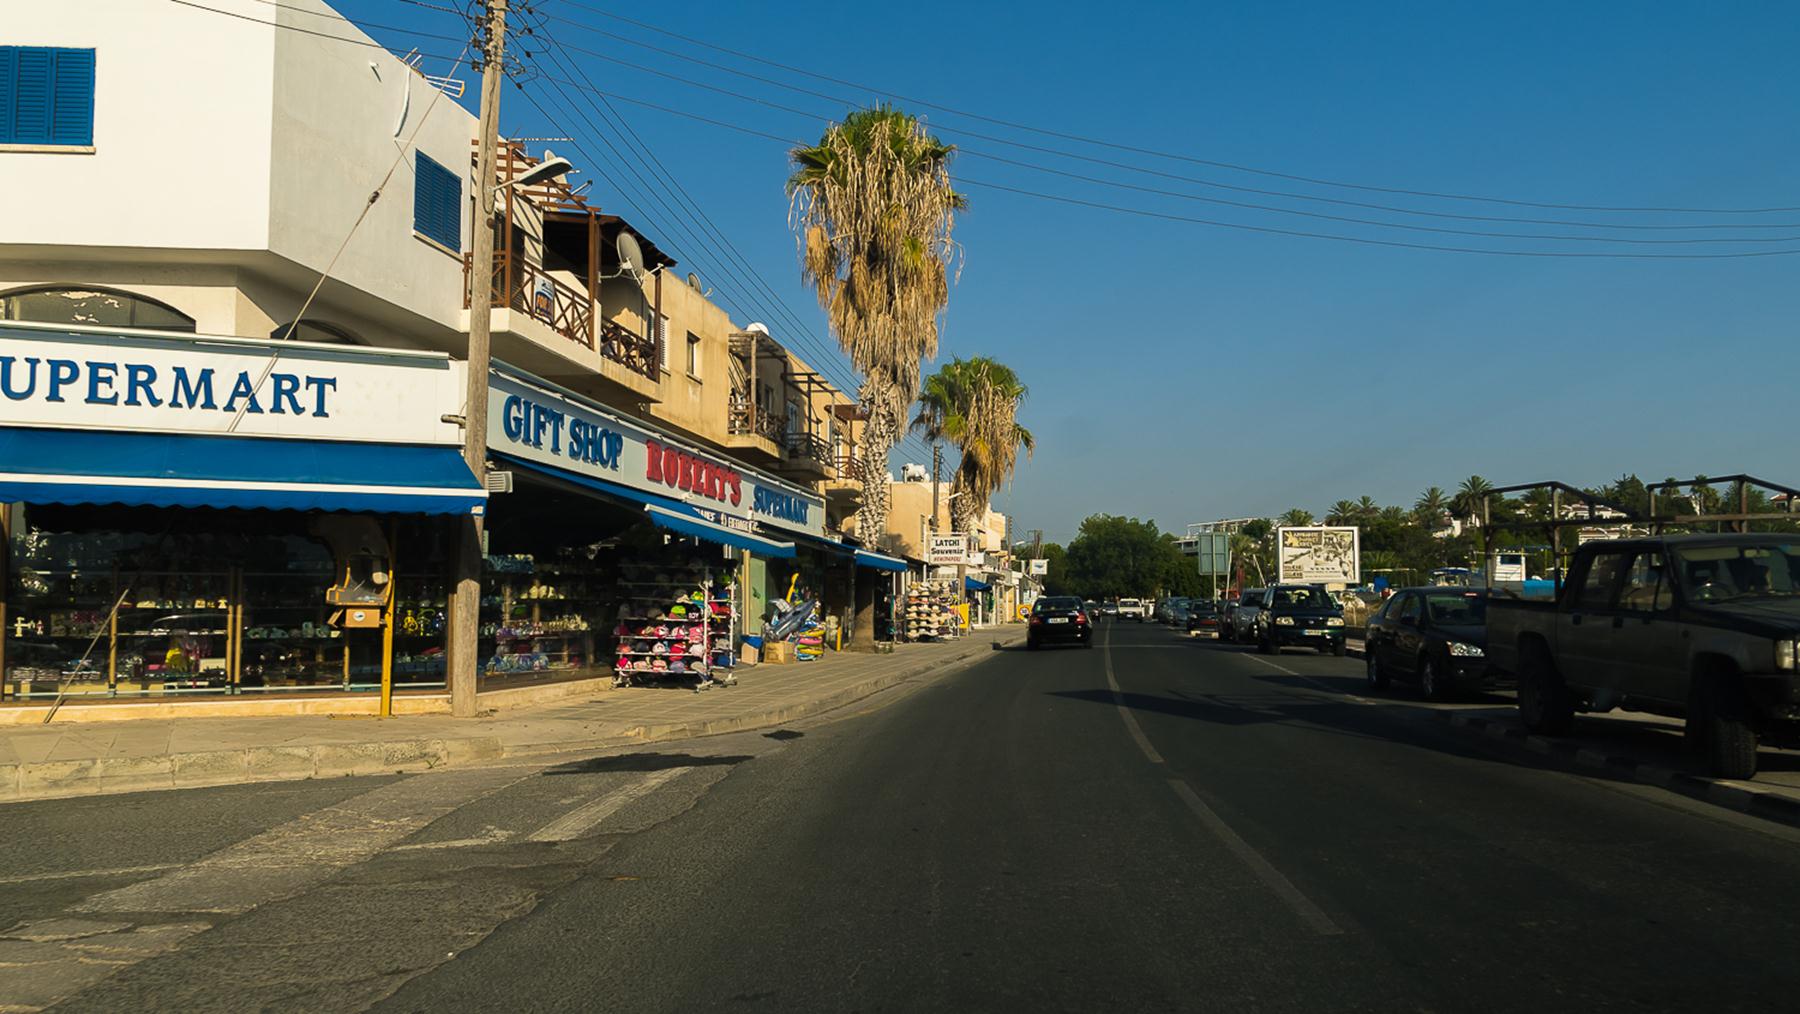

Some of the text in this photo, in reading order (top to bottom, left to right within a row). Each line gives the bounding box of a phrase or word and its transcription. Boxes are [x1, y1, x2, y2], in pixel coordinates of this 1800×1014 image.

[503, 394, 623, 472] GIFT SHOP
[646, 439, 742, 508] ROBERT'S
[753, 484, 809, 526] SUPERMART
[931, 547, 964, 555] Souvenir
[935, 539, 960, 547] LATCHI
